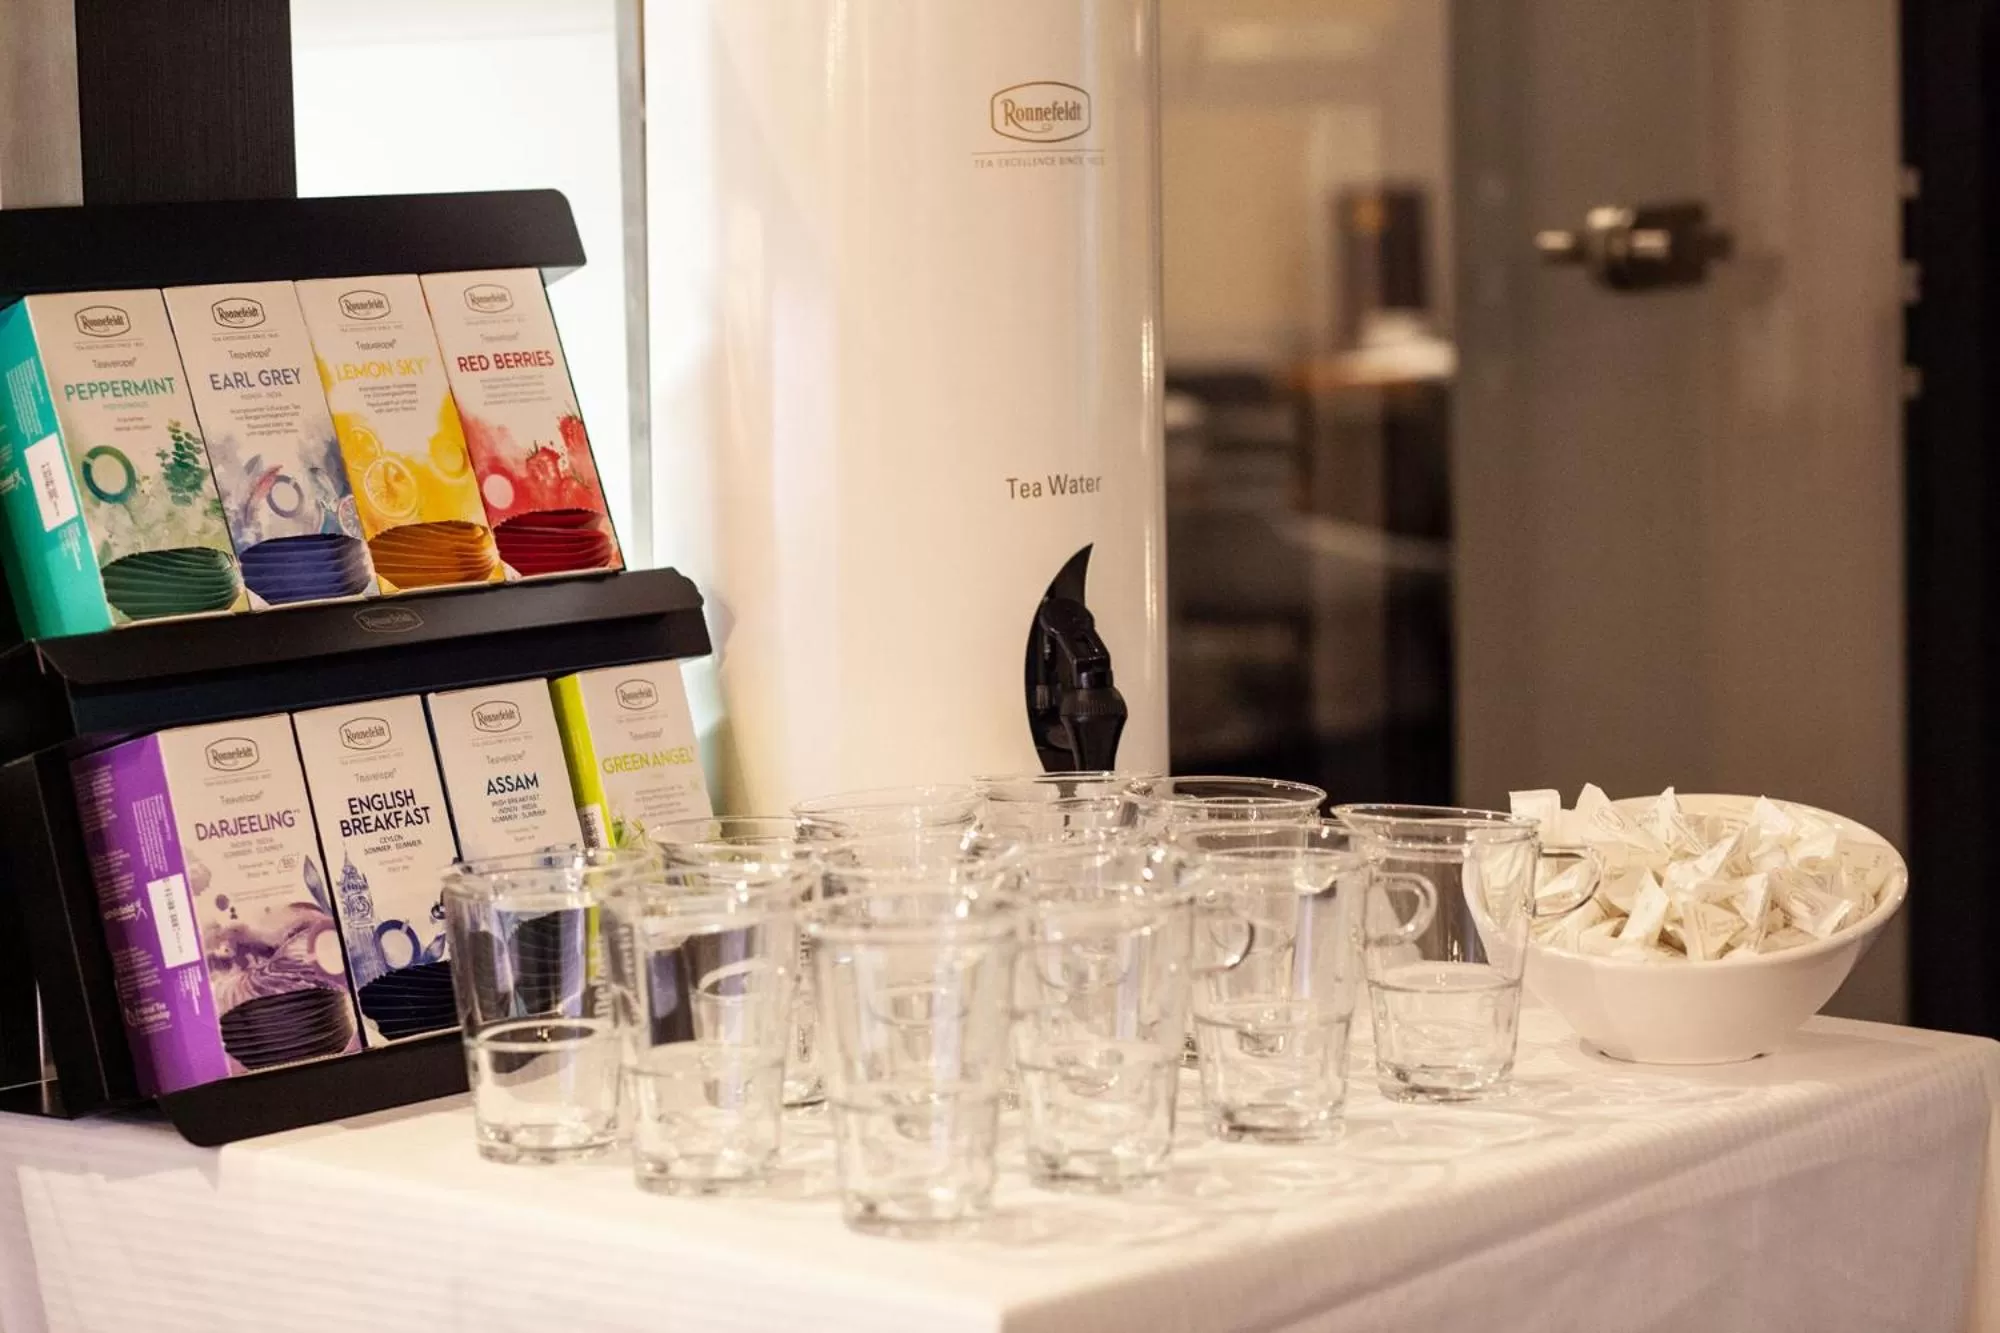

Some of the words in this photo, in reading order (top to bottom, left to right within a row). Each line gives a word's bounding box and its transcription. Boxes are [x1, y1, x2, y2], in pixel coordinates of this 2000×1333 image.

[1000, 98, 1082, 133] Ronnefeldt
[335, 360, 393, 383] LEMON
[457, 354, 490, 373] RED
[494, 350, 554, 370] BERRIES
[64, 376, 174, 402] PEPPERMINT
[209, 371, 255, 391] EARL
[258, 367, 301, 386] GREY
[1005, 478, 1042, 499] Tea
[1047, 473, 1102, 496] Water
[602, 752, 649, 774] GREEN
[487, 772, 539, 796] ASSAM
[348, 789, 417, 815] ENGLISH
[340, 806, 431, 838] BREAKFAST
